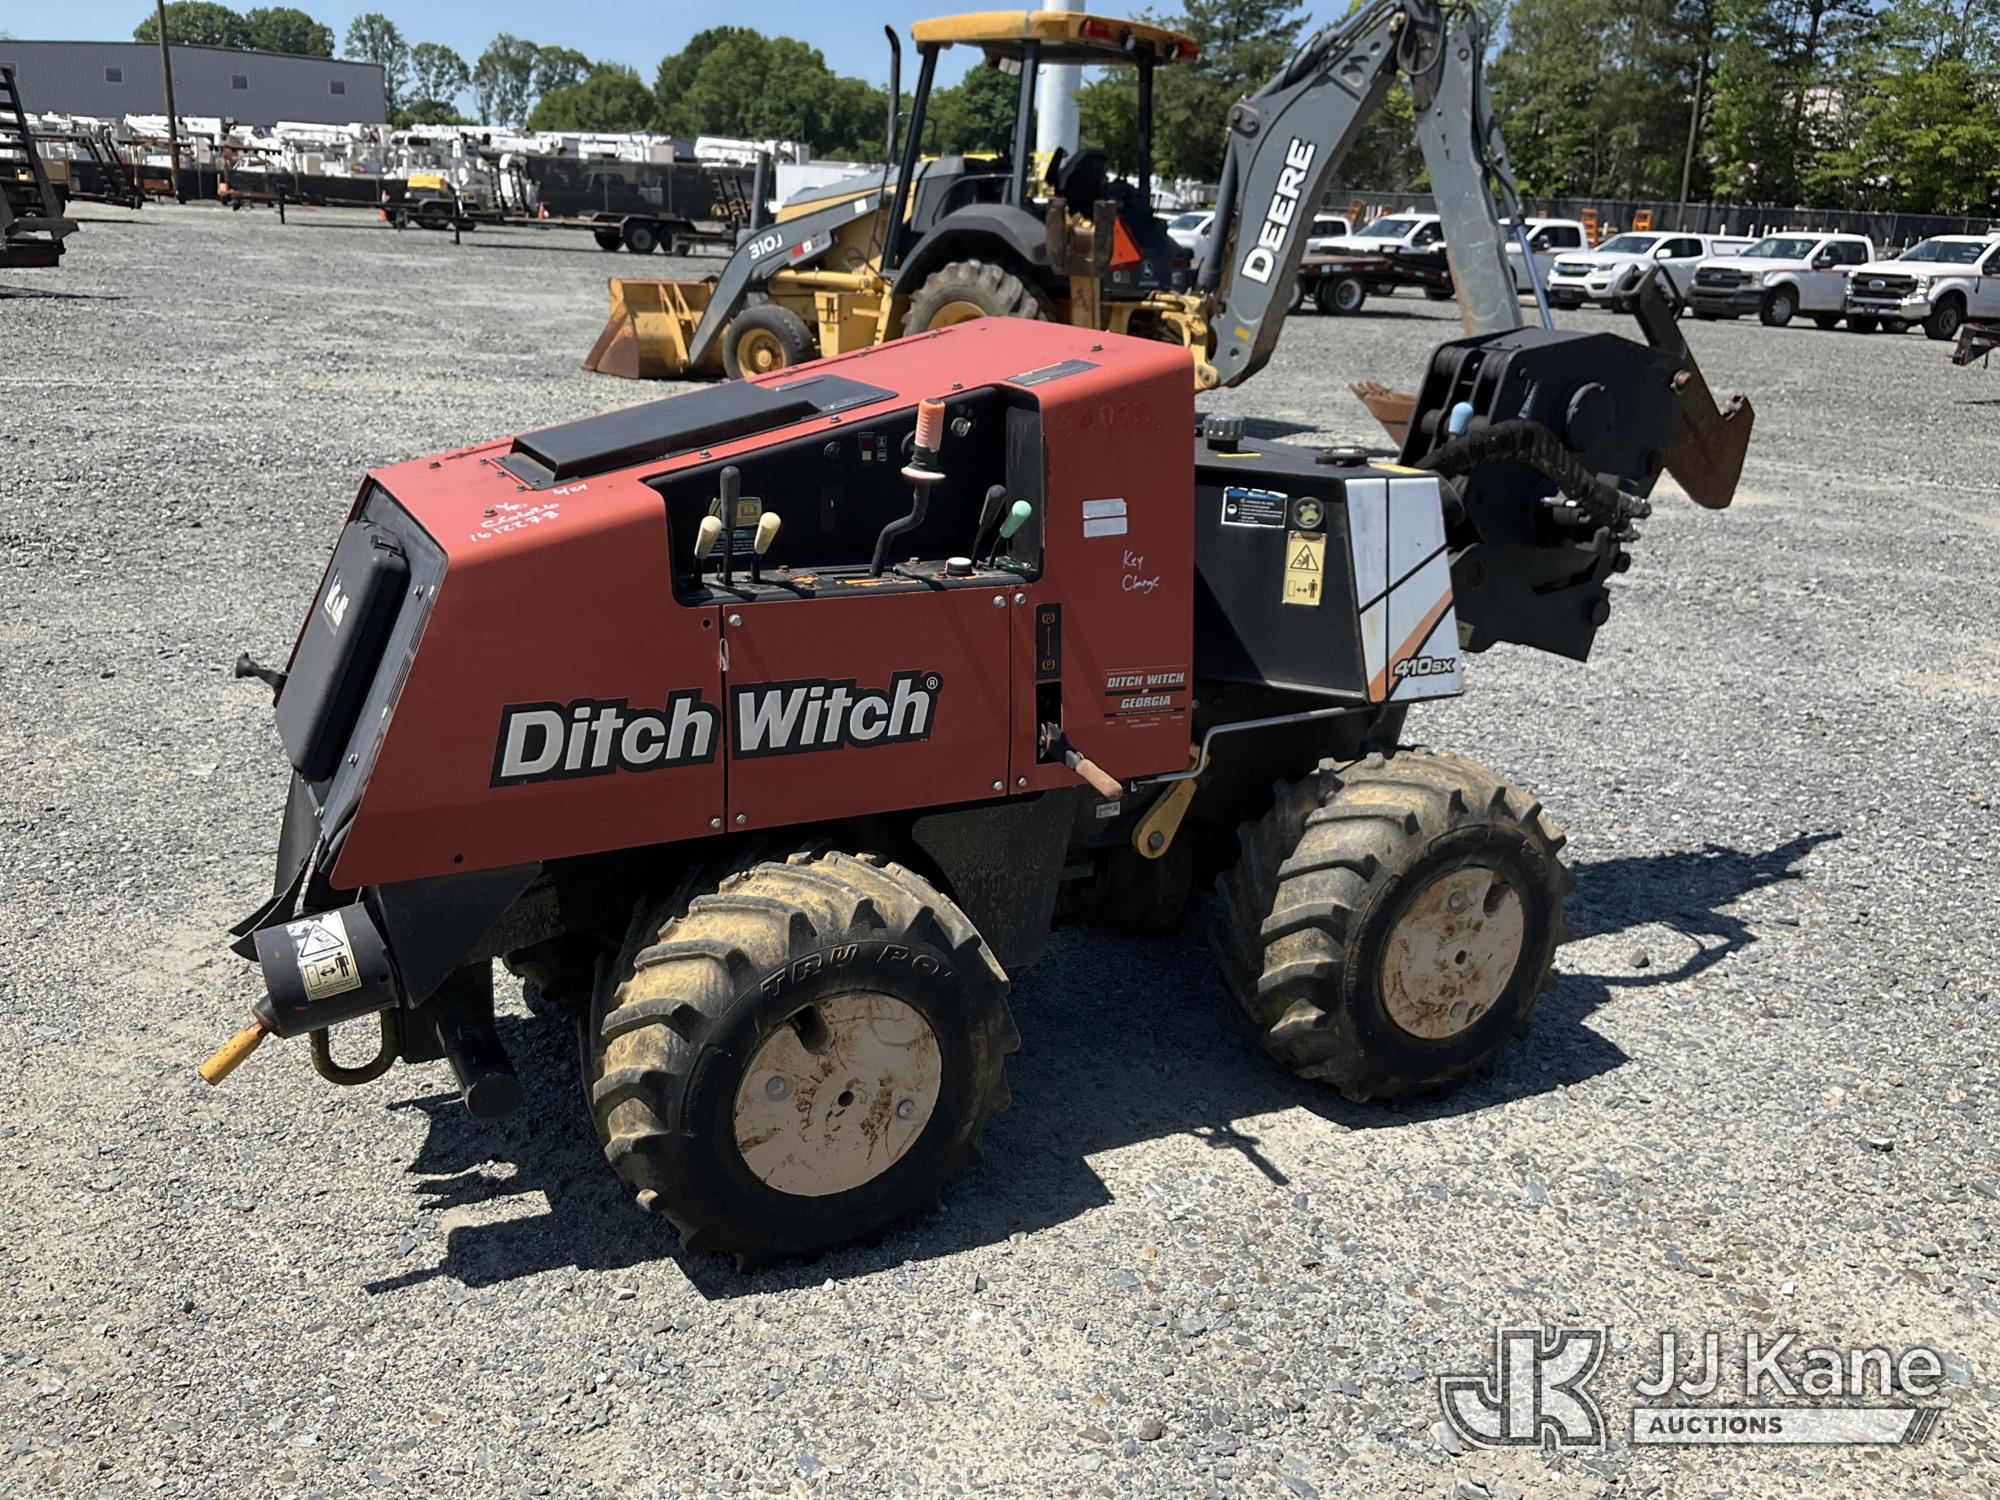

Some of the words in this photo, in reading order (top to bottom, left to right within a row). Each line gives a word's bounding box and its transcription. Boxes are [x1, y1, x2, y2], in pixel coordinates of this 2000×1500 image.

[1241, 138, 1316, 283] DEERE
[748, 233, 783, 260] 310J
[1122, 549, 1144, 570] Key
[1107, 675, 1144, 688] DITCH
[1147, 672, 1185, 685] WITCH
[1121, 695, 1171, 709] GEORGIA
[499, 697, 713, 777] Ditch
